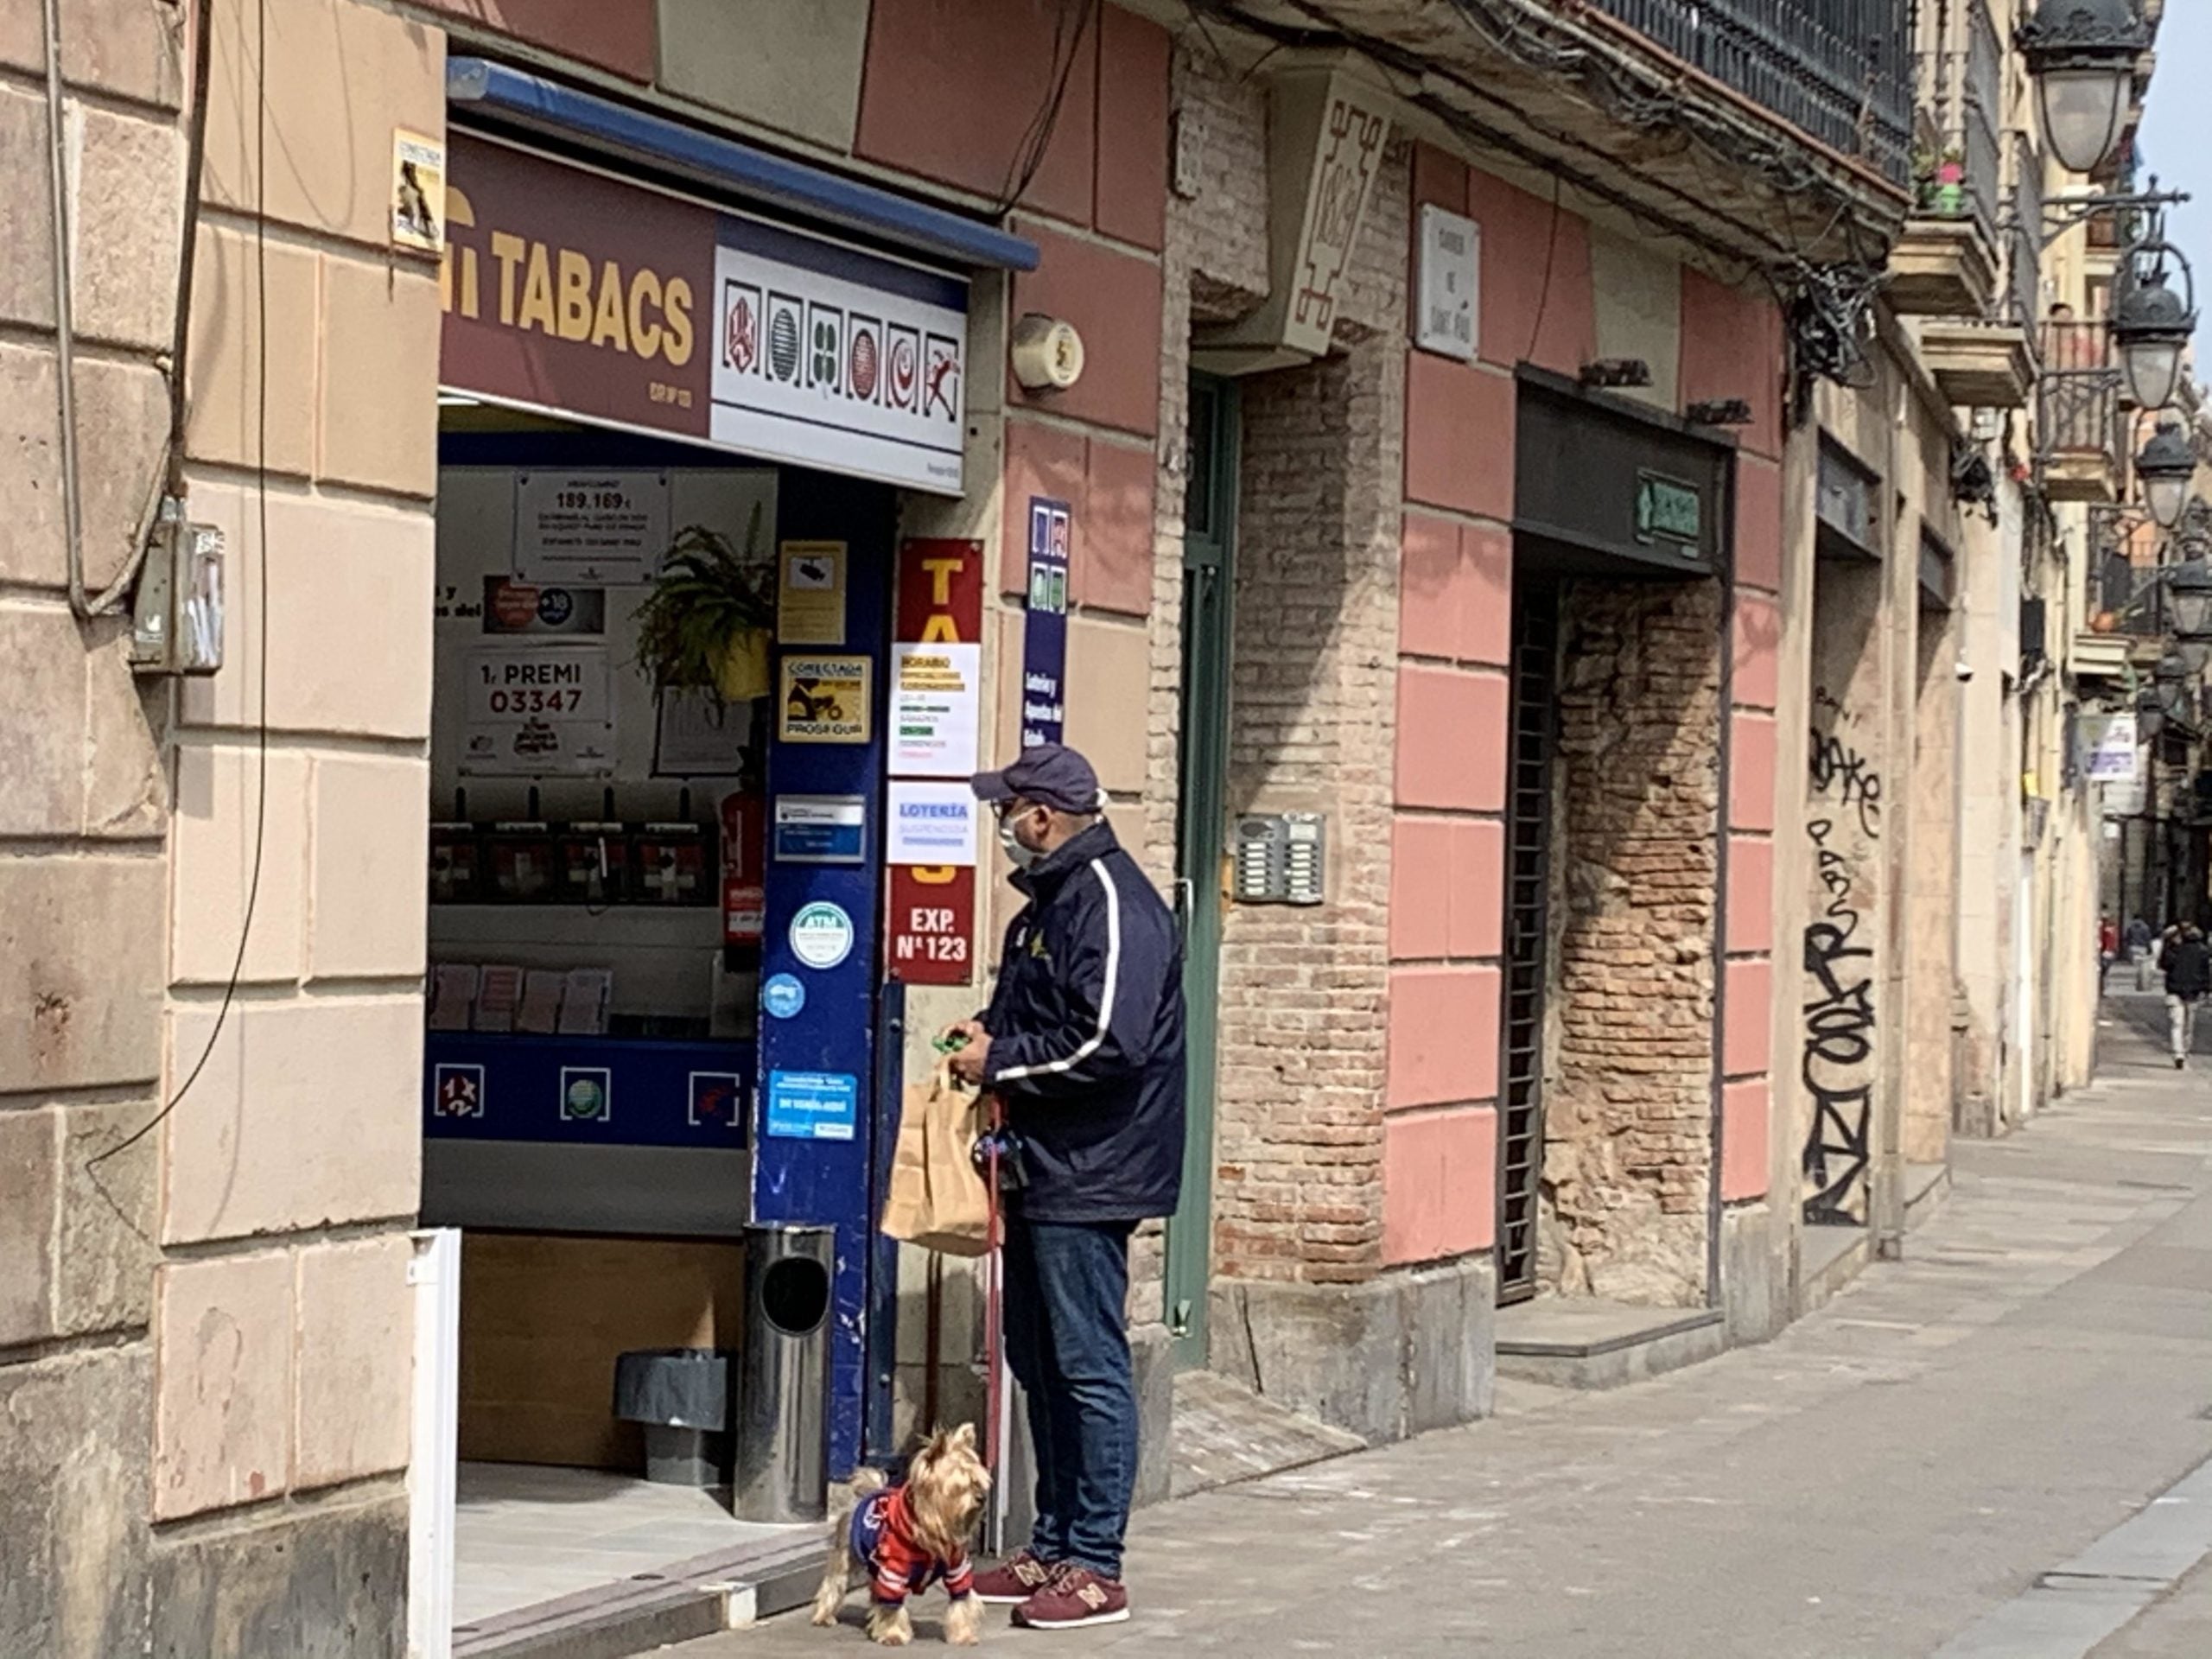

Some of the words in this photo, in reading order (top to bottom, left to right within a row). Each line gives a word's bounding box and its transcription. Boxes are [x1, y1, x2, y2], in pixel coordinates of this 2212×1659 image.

[491, 230, 692, 366] TABACS
[504, 663, 582, 684] PREMI
[489, 689, 583, 714] 03347
[899, 803, 969, 819] LOTERÍA
[910, 906, 956, 934] EXP.
[926, 936, 968, 963] 123
[1014, 1559, 1048, 1587] N
[1076, 1581, 1109, 1611] N
